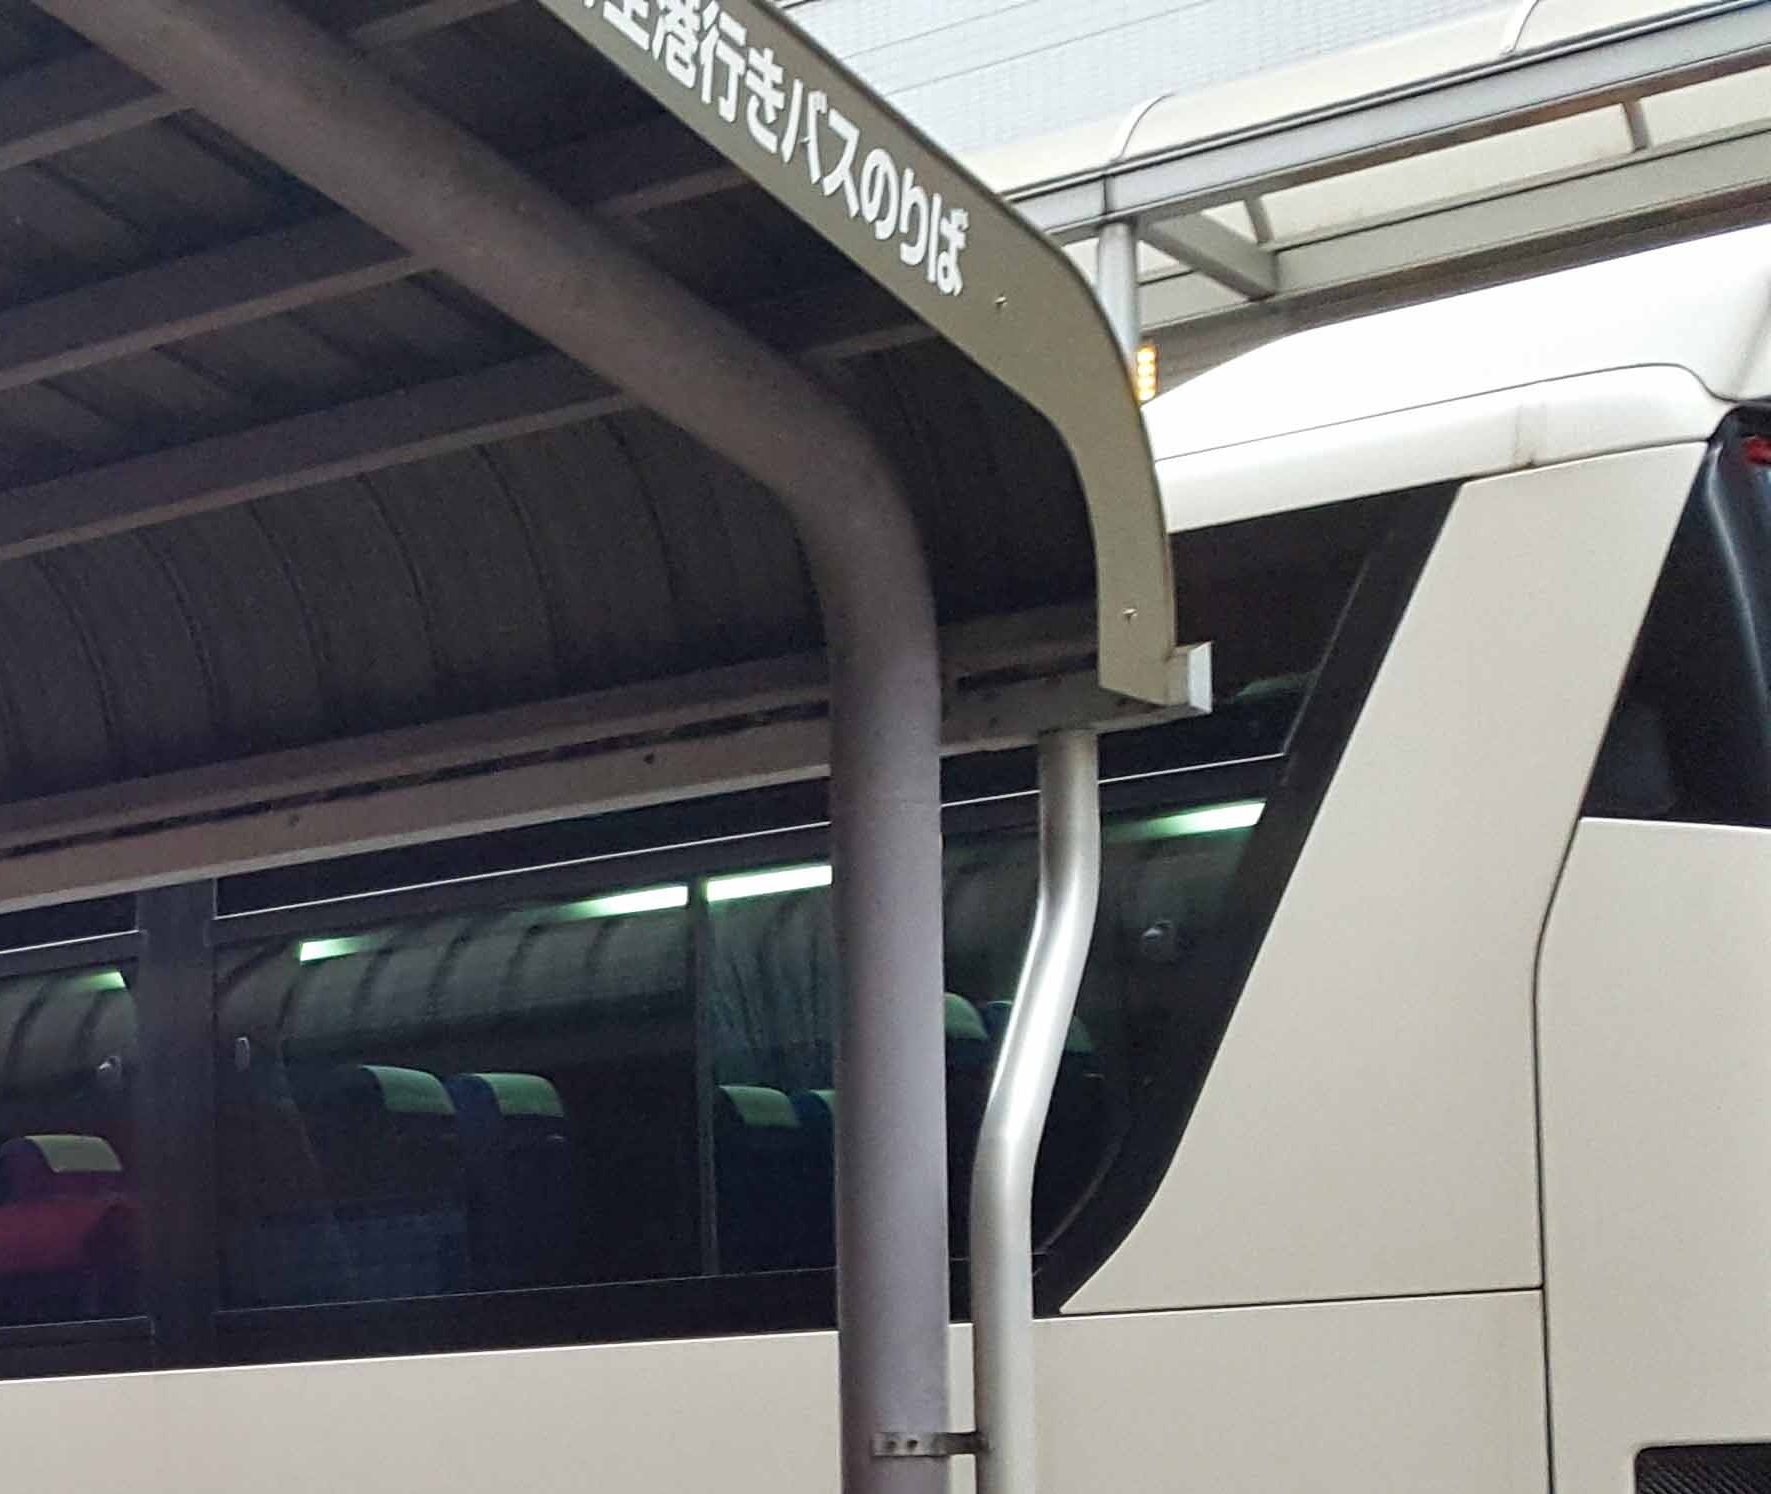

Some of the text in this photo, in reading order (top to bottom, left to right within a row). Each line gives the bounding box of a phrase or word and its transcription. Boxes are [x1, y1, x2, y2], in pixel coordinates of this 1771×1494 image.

[584, 0, 969, 296] 港行きバスのりば
